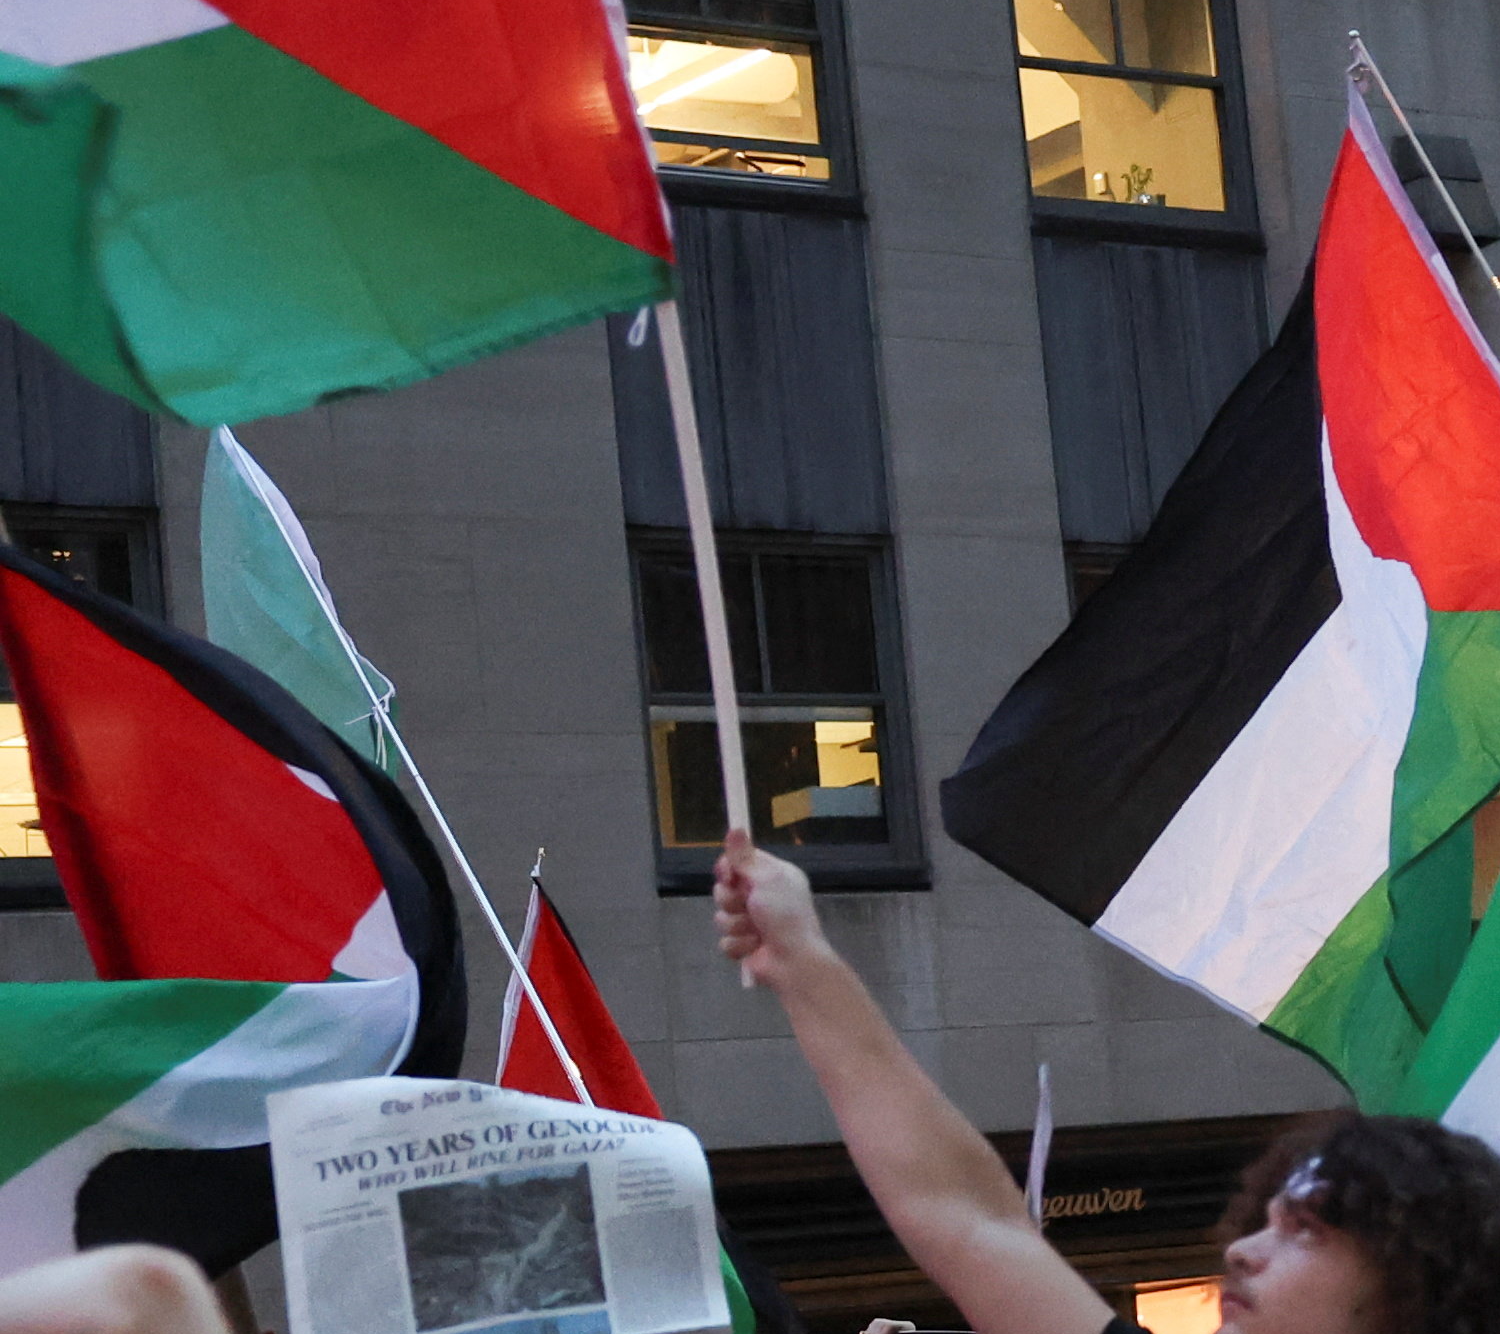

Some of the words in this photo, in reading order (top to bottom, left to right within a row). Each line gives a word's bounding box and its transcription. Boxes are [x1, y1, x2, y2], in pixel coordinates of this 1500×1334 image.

[316, 1150, 378, 1182] TWO
[386, 1131, 475, 1166] YEARS
[483, 1123, 520, 1145] OF
[358, 1171, 407, 1192] WHO
[414, 1160, 457, 1181] WILL
[563, 1136, 625, 1156] GAZA?
